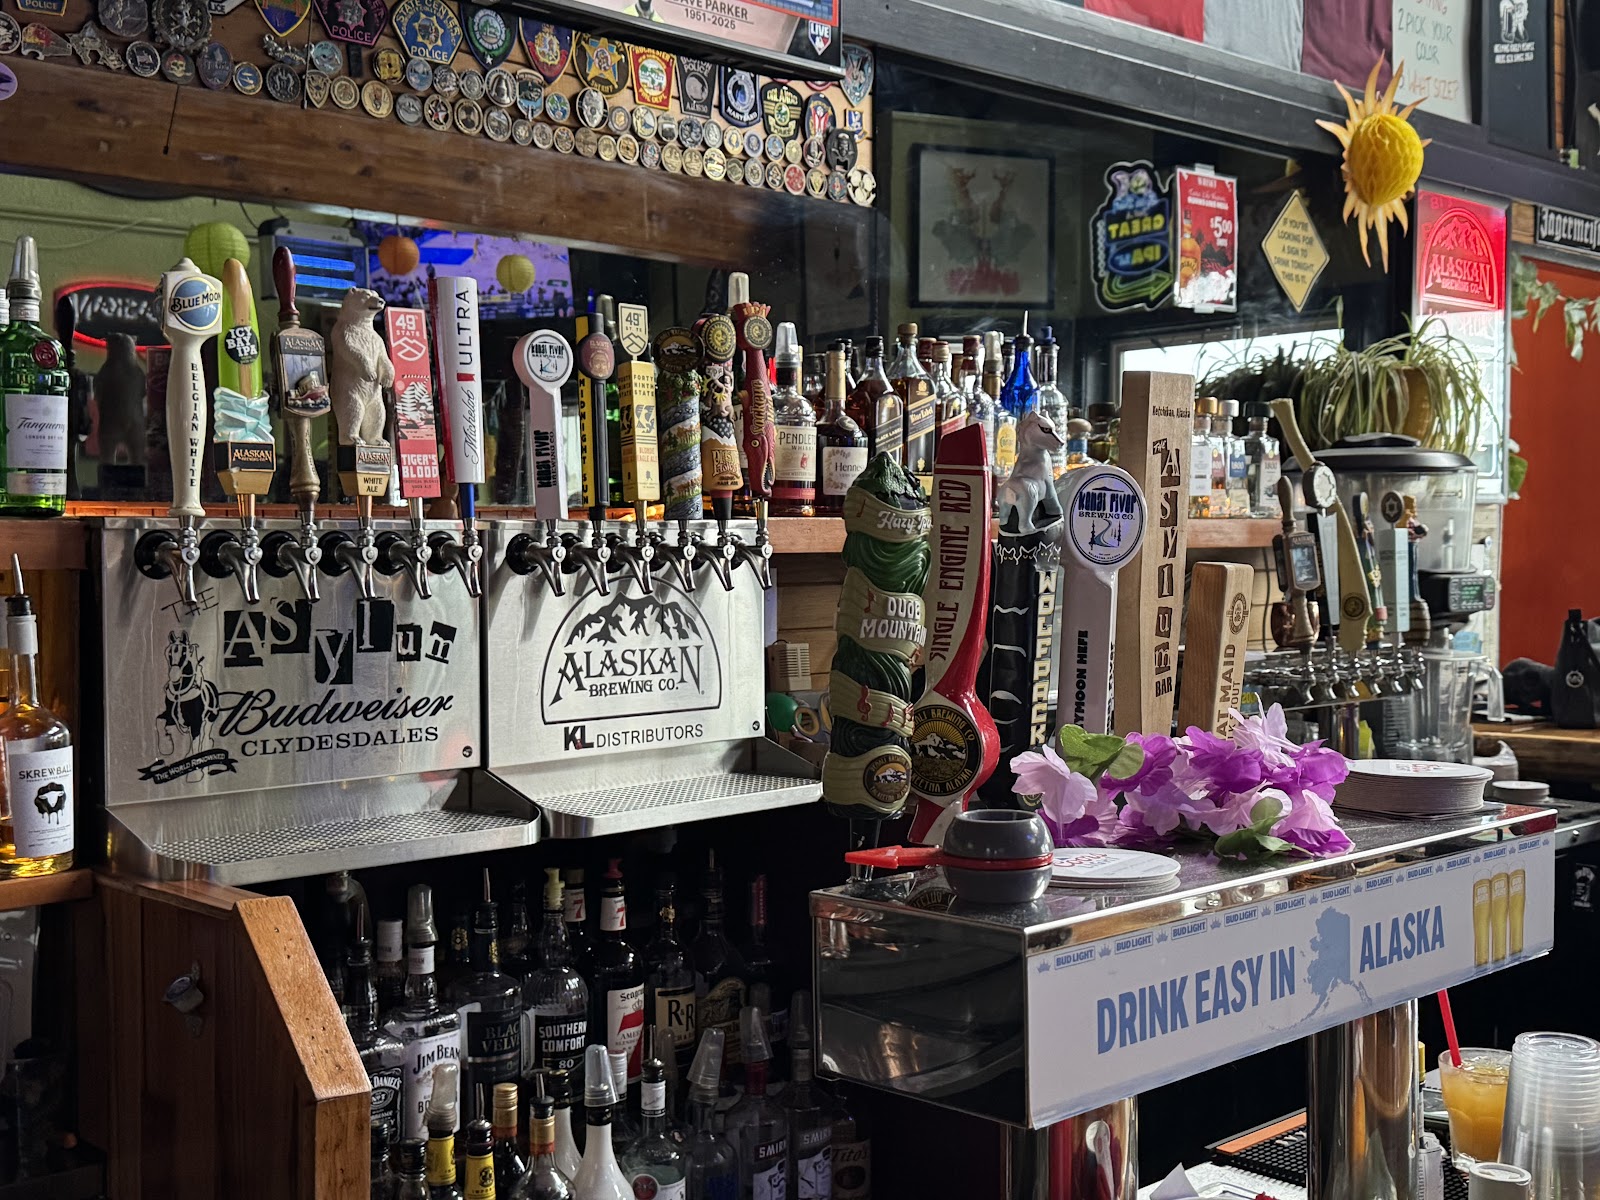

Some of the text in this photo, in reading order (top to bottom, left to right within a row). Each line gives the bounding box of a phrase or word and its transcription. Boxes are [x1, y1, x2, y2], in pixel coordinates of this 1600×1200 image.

[704, 0, 749, 20] PARKER
[684, 8, 737, 30] 1951-2025
[1405, 12, 1426, 37] PICK
[331, 25, 373, 42] POLICE
[809, 21, 831, 38] LIVE
[410, 45, 449, 61] POLICE
[1277, 229, 1314, 246] LOOKING FOR
[1425, 252, 1493, 301] ALASKAN
[171, 296, 201, 312] BLUE
[229, 325, 253, 339] ICY
[396, 329, 420, 337] STATE
[226, 336, 252, 350] BAY
[236, 344, 259, 358] IPA
[285, 337, 324, 352] ALASKAN
[456, 286, 479, 465] Michelob ULTRA
[633, 374, 654, 382] FORTY
[634, 382, 655, 390] NINTH
[634, 389, 655, 397] STATE
[189, 362, 200, 488] BELGIAN WHITE
[579, 378, 587, 465] MIDNIGHT
[232, 448, 273, 463] ALASKAN
[357, 450, 391, 466] ALASKAN
[400, 453, 438, 466] TIGER'S
[402, 465, 439, 478] BLOOD
[363, 477, 383, 485] WHITE
[366, 485, 379, 493] ALE
[876, 510, 917, 535] Hazy
[1078, 511, 1136, 521] BREWING CO.
[929, 479, 972, 662] SINGLE ENGINE RED
[161, 587, 220, 622] THE
[1030, 570, 1058, 746] WOLFPACK
[548, 645, 705, 708] ALASKAN
[1073, 629, 1090, 729] YMOON HEFE
[588, 678, 680, 698] BREWING CO.
[1155, 681, 1173, 698] BAR
[1216, 643, 1236, 738] AT MAID
[219, 687, 455, 737] Budweiser
[930, 708, 967, 732] BREWING
[241, 726, 440, 758] CLYDESDALES
[563, 723, 703, 751] KL DISTRIBUTORS
[155, 752, 226, 781] THE WORLD RENOWNED
[945, 768, 974, 791] ALASKA
[1367, 876, 1392, 889] BUD LIGHT
[1322, 886, 1350, 899] BUD LIGHT
[1275, 897, 1305, 911] BUD LIGHT
[1225, 908, 1257, 924] BUD LIGHT
[1173, 921, 1206, 938] BUD LIGHT
[1116, 935, 1152, 951] BUD LIGHT
[1359, 905, 1445, 973] ALASKA
[1056, 949, 1094, 966] BUD LIGHT
[1096, 946, 1296, 1055] DRINK EASY IN
[538, 1020, 588, 1039] SOUTHERN
[541, 1034, 586, 1053] COMFORT
[412, 1053, 435, 1075] JIM
[558, 1058, 575, 1070] 80
